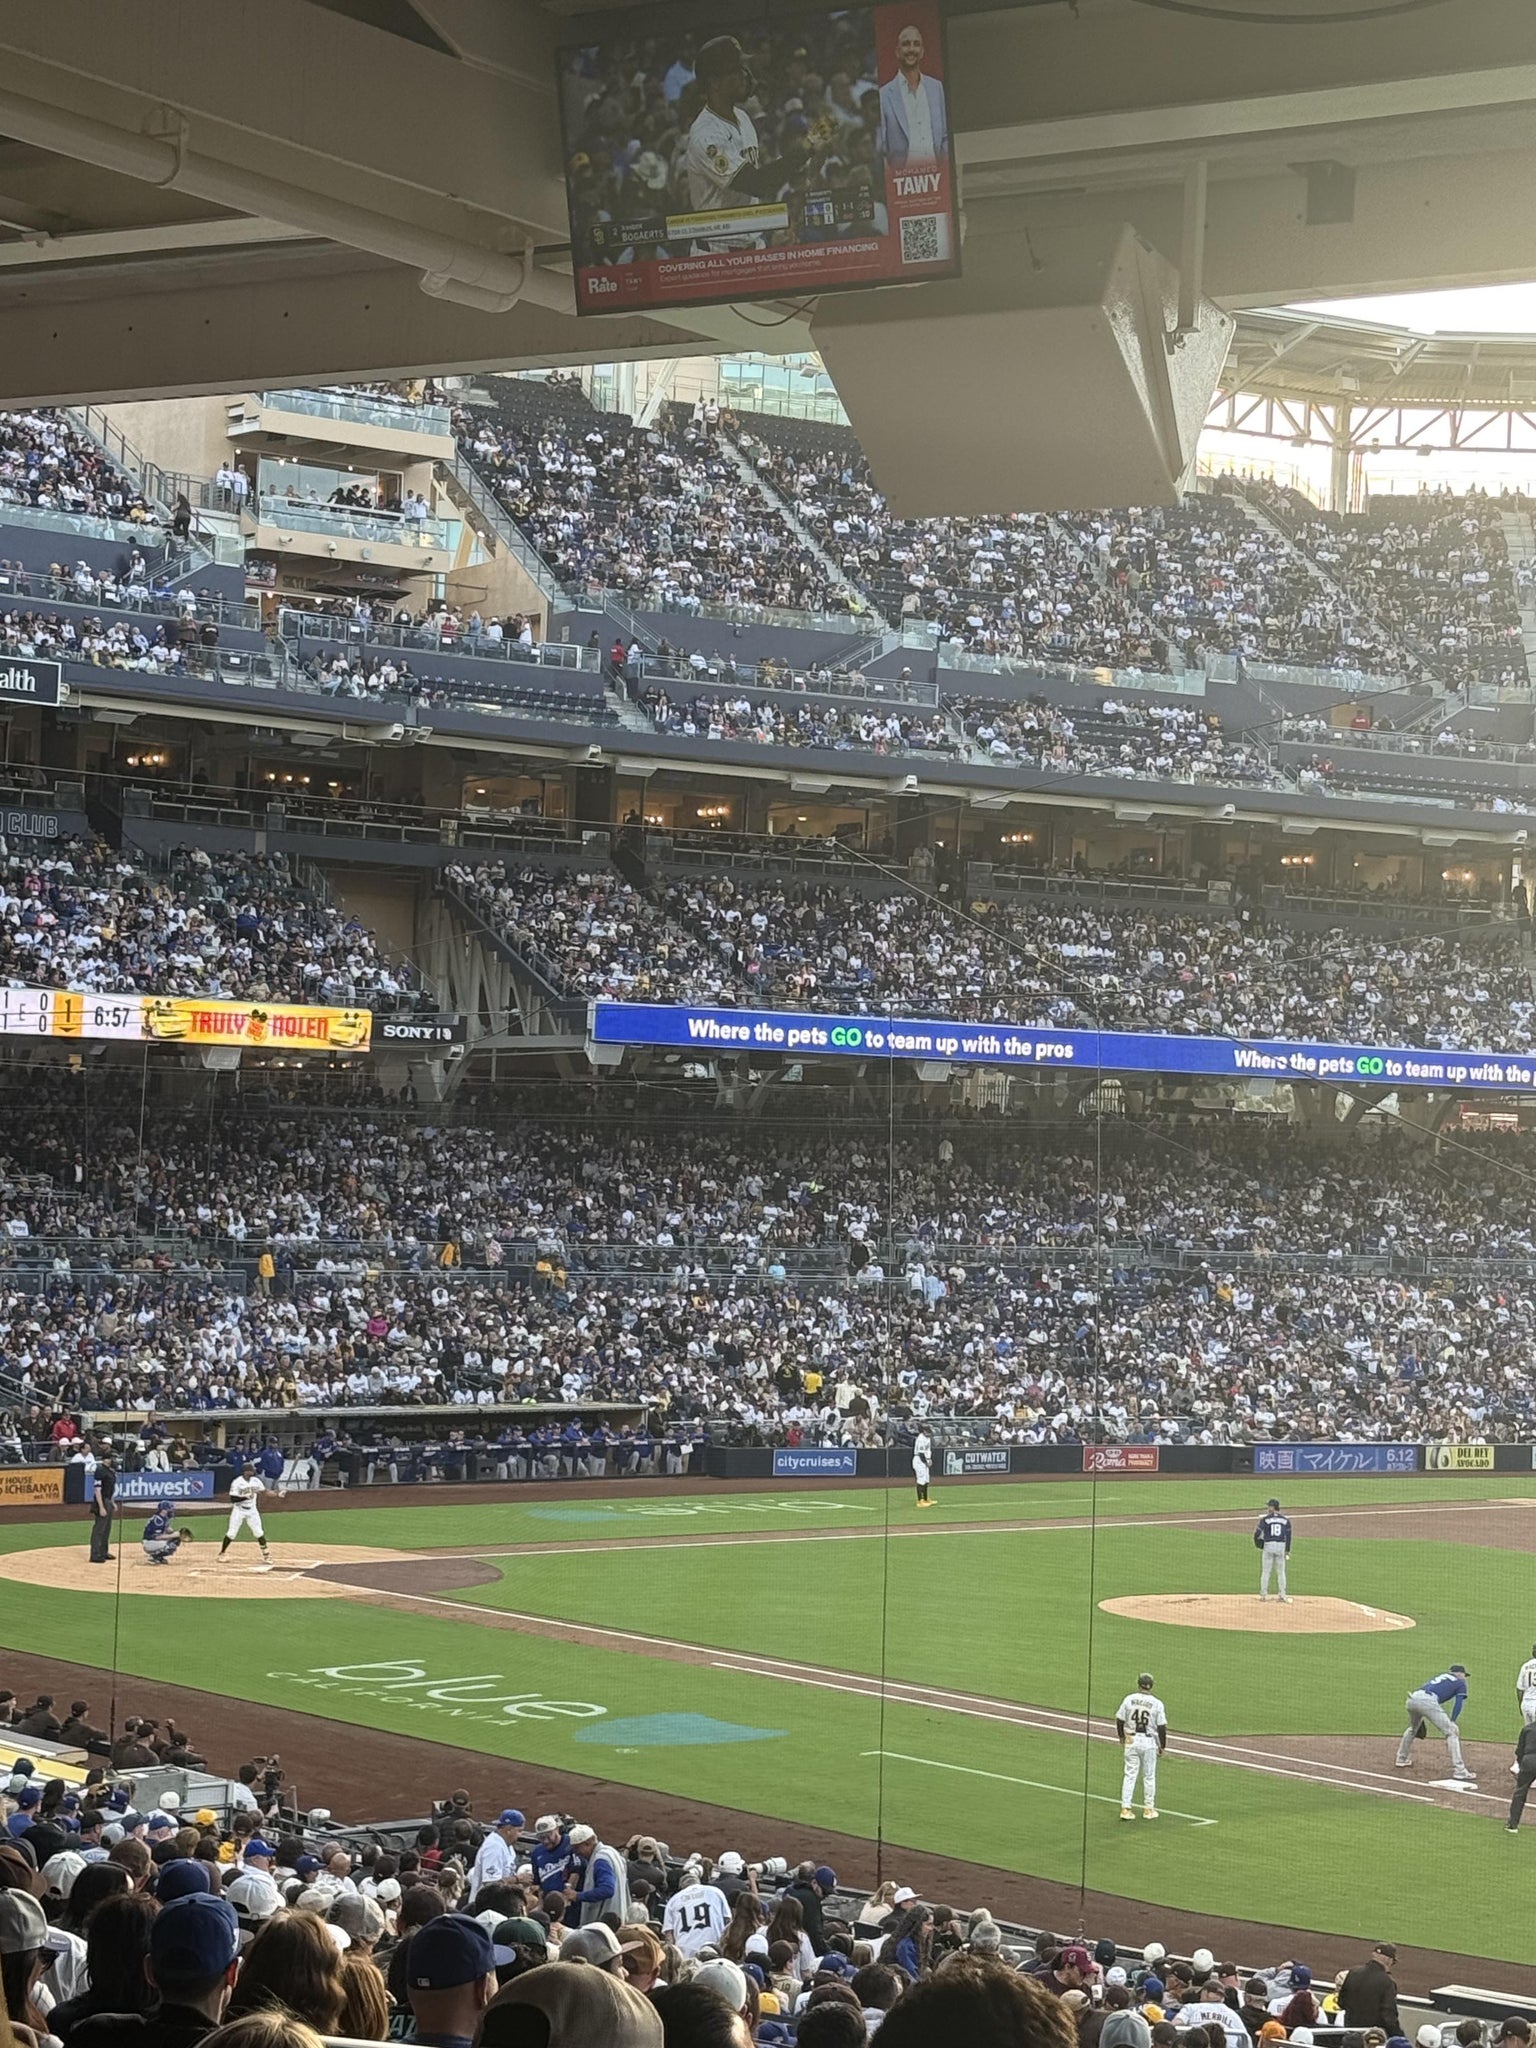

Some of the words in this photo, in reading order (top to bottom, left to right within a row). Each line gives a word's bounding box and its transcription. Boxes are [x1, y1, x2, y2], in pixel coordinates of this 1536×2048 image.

[893, 172, 942, 197] TAWY
[622, 229, 665, 243] BOGAERTS
[658, 258, 707, 273] COVERING
[707, 256, 727, 268] ALL
[728, 253, 753, 266] YOUR
[755, 250, 786, 263] BASES
[787, 249, 797, 260] IN
[798, 246, 826, 259] HOME
[826, 242, 879, 257] FINANCING
[588, 276, 618, 294] Rate
[0, 667, 36, 692] alth
[7, 812, 58, 838] CLUB
[40, 992, 48, 1011] 0
[65, 998, 72, 1023] 1
[19, 1003, 26, 1021] E
[95, 1006, 130, 1028] 6:57
[39, 1014, 47, 1033] 0
[190, 1011, 247, 1035] TRULY
[383, 1025, 434, 1039] SONY
[688, 1019, 750, 1041] Where
[754, 1023, 784, 1042] the
[787, 1027, 827, 1049] pets
[831, 1027, 862, 1047] GO
[865, 1030, 885, 1048] to
[888, 1031, 932, 1051] team
[935, 1036, 958, 1057] up
[962, 1036, 1000, 1055] with
[1004, 1038, 1032, 1057] the
[1035, 1043, 1073, 1063] pros
[1233, 1049, 1288, 1070] Where
[1289, 1053, 1315, 1072] the
[1318, 1056, 1354, 1077] pets
[1356, 1056, 1384, 1076] GO
[1385, 1058, 1403, 1077] to
[1405, 1060, 1444, 1079] team
[1446, 1063, 1467, 1083] up
[1469, 1062, 1503, 1082] with
[1505, 1064, 1531, 1084] the
[777, 1454, 841, 1470] citycruises
[965, 1451, 1007, 1464] CUTWATER
[1259, 1450, 1295, 1470] 映画
[1303, 1449, 1373, 1471] マイケル
[1386, 1449, 1414, 1462] 6.12
[1457, 1448, 1473, 1458] DEL
[1474, 1448, 1490, 1458] REY
[1456, 1459, 1490, 1468] AVOCADO
[5, 1476, 32, 1485] HOUSE
[5, 1483, 60, 1495] ICHIBANYA
[114, 1477, 191, 1498] uthwest
[1270, 1523, 1282, 1537] 18
[266, 1671, 518, 1726] CALIFORNIA
[306, 1659, 609, 1720] blue
[1131, 1709, 1150, 1726] 46
[678, 1902, 712, 1933] 19
